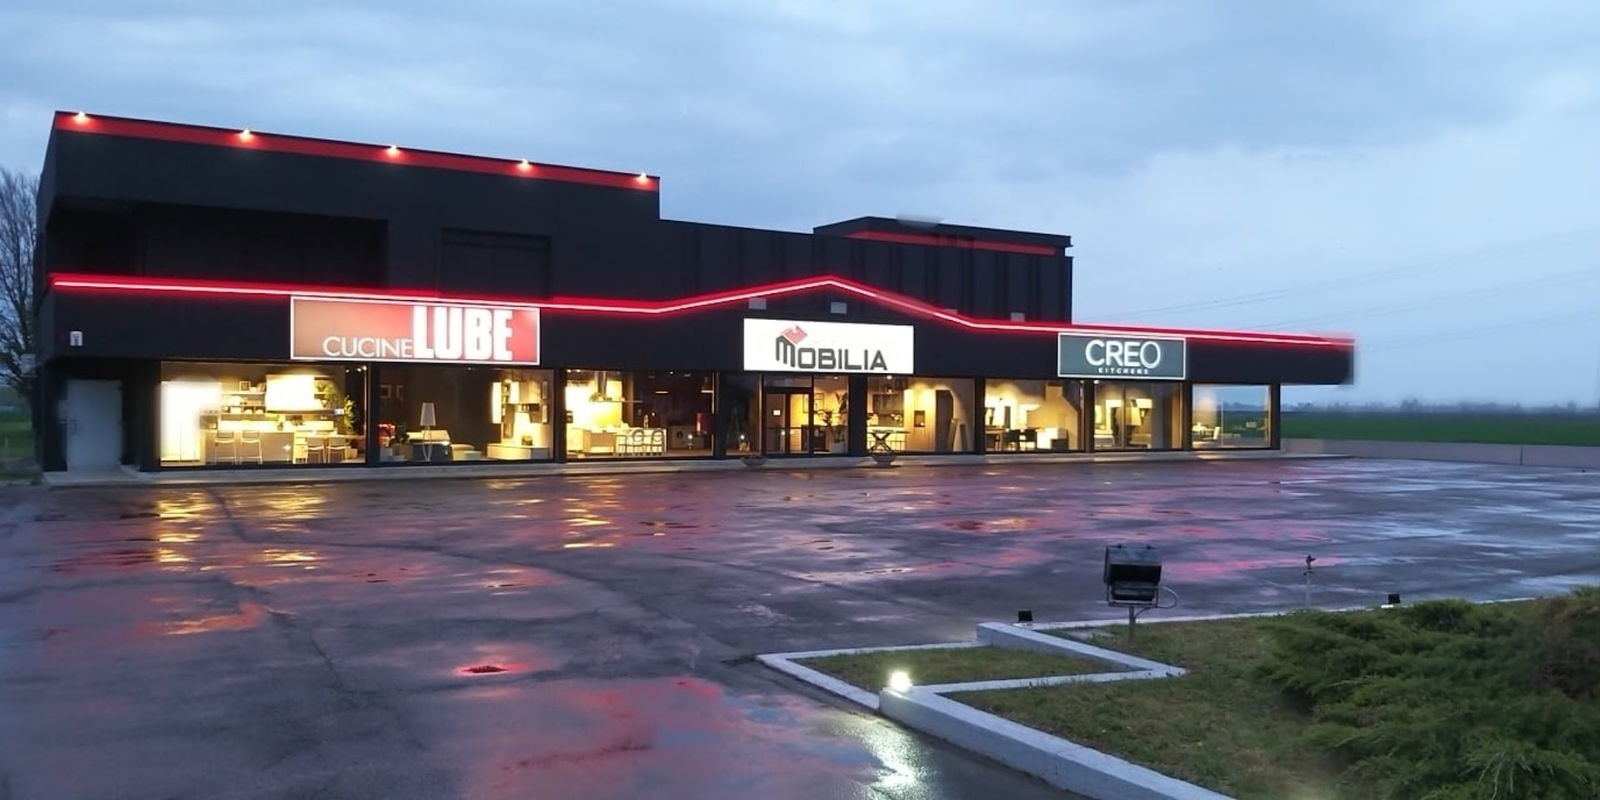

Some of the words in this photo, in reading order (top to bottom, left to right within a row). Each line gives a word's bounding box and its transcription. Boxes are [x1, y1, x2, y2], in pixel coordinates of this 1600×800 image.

[323, 336, 413, 358] CUCINE
[413, 305, 513, 361] LUBE
[1085, 339, 1161, 369] CREO
